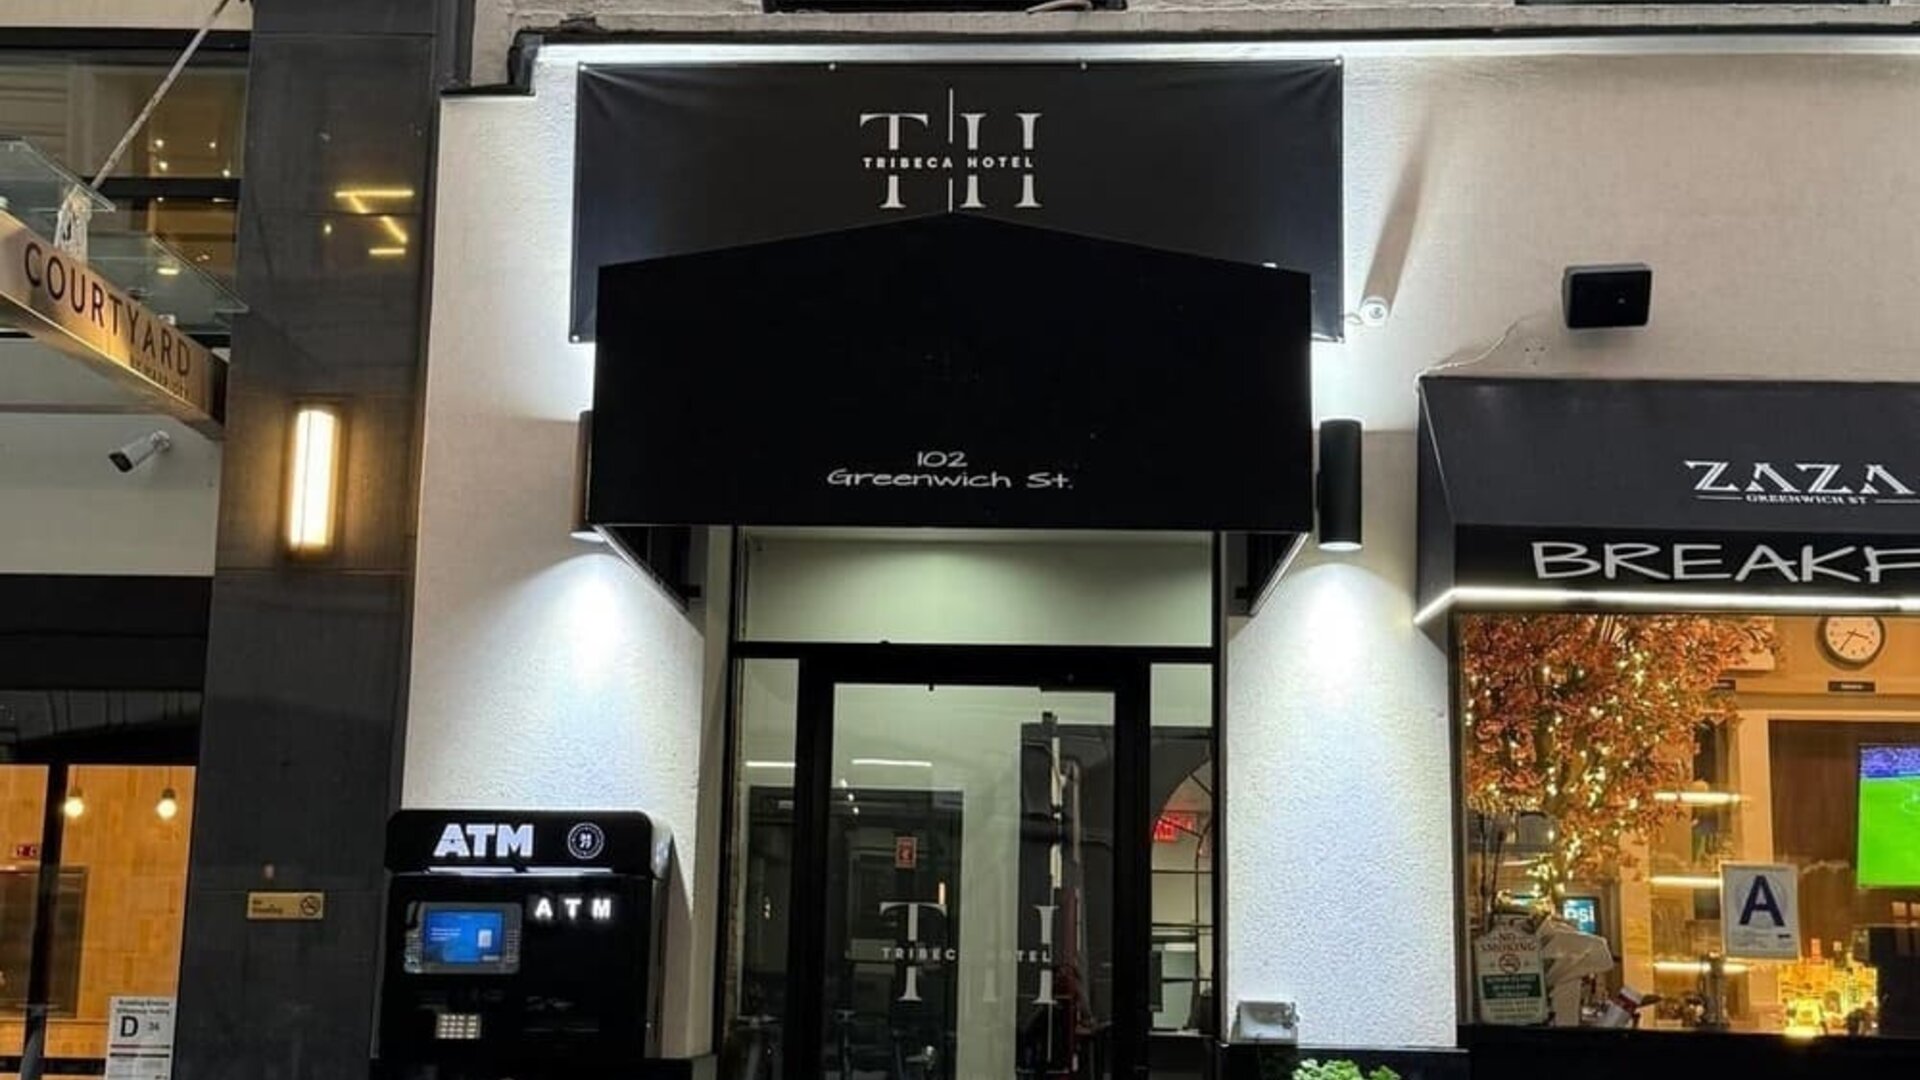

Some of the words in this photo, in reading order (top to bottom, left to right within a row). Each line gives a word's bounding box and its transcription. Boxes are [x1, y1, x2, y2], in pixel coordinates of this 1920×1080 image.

[862, 157, 953, 169] TRIBECA
[966, 157, 1033, 169] HOTEL
[24, 242, 191, 376] COURTYARD
[917, 450, 968, 467] 102
[827, 468, 1011, 488] Greenwich
[1026, 471, 1073, 489] St.
[1684, 460, 1916, 494] ZAZA
[1745, 493, 1845, 505] GREENWICH
[1847, 495, 1867, 506] ST
[433, 823, 535, 858] ATM
[534, 897, 612, 920] ATM
[1739, 874, 1785, 927] A
[881, 947, 957, 961] TRIBEC
[120, 1015, 139, 1037] D
